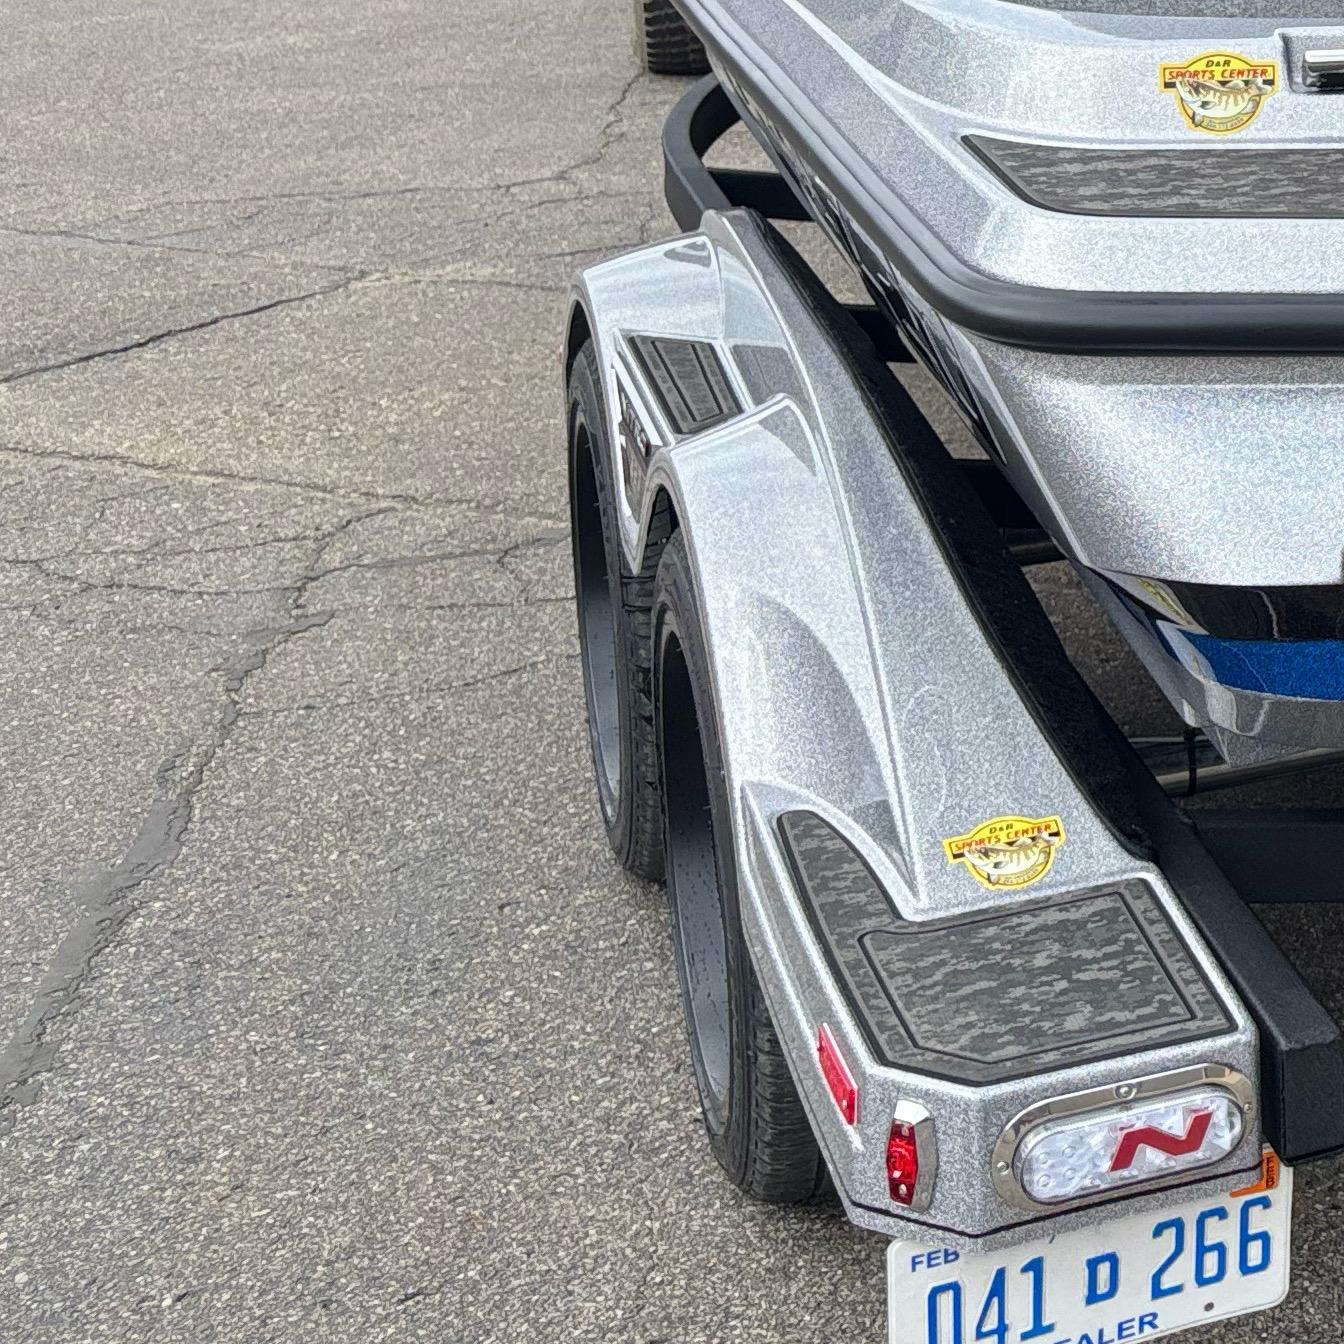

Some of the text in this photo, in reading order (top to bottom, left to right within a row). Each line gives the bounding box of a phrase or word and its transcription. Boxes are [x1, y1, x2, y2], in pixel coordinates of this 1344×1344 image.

[1168, 67, 1269, 81] SPORTS CENTER
[1205, 59, 1232, 69] D&R
[911, 1248, 961, 1273] FEB
[926, 1194, 1274, 1344] 041 D 266
[1052, 1312, 1160, 1344] ALER
